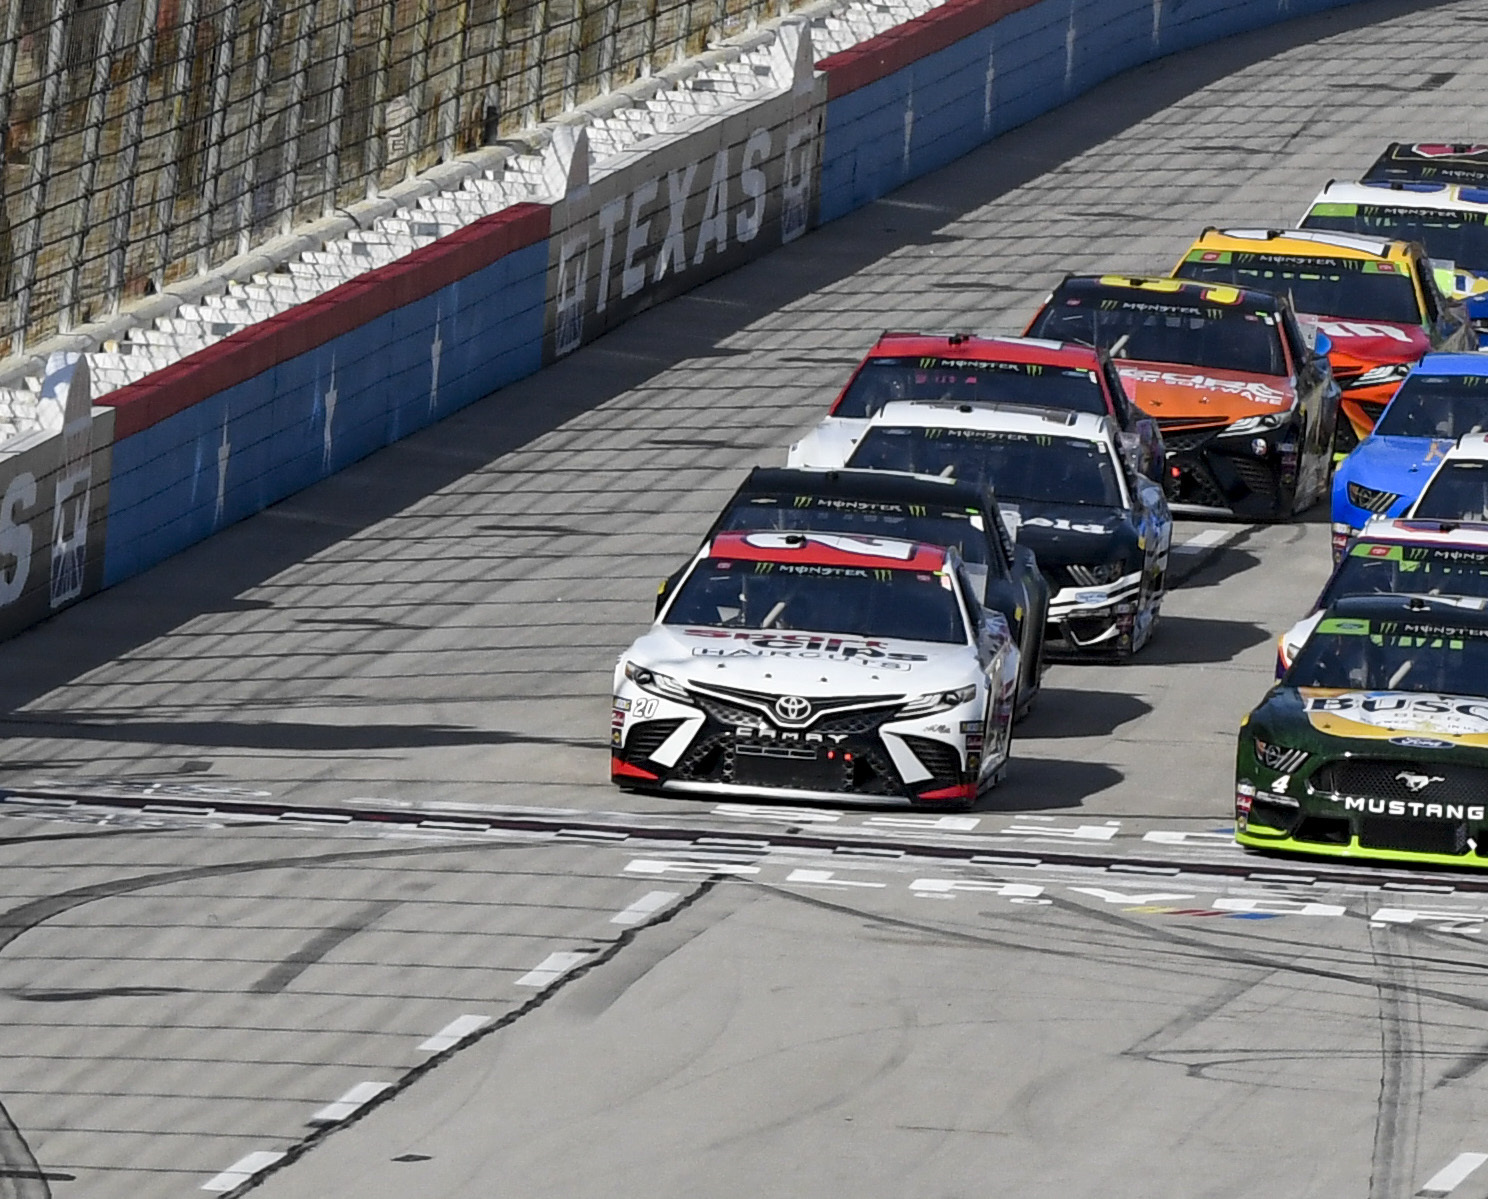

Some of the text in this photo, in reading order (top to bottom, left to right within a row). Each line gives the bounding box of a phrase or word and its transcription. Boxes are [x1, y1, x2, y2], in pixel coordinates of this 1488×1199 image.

[596, 128, 772, 313] TEXAS
[818, 499, 902, 513] MONSTER
[780, 565, 868, 578] MONSTER
[633, 698, 658, 718] 20
[735, 727, 849, 744] CAMRY
[1271, 774, 1291, 794] 4
[1345, 797, 1485, 820] MUSTANG
